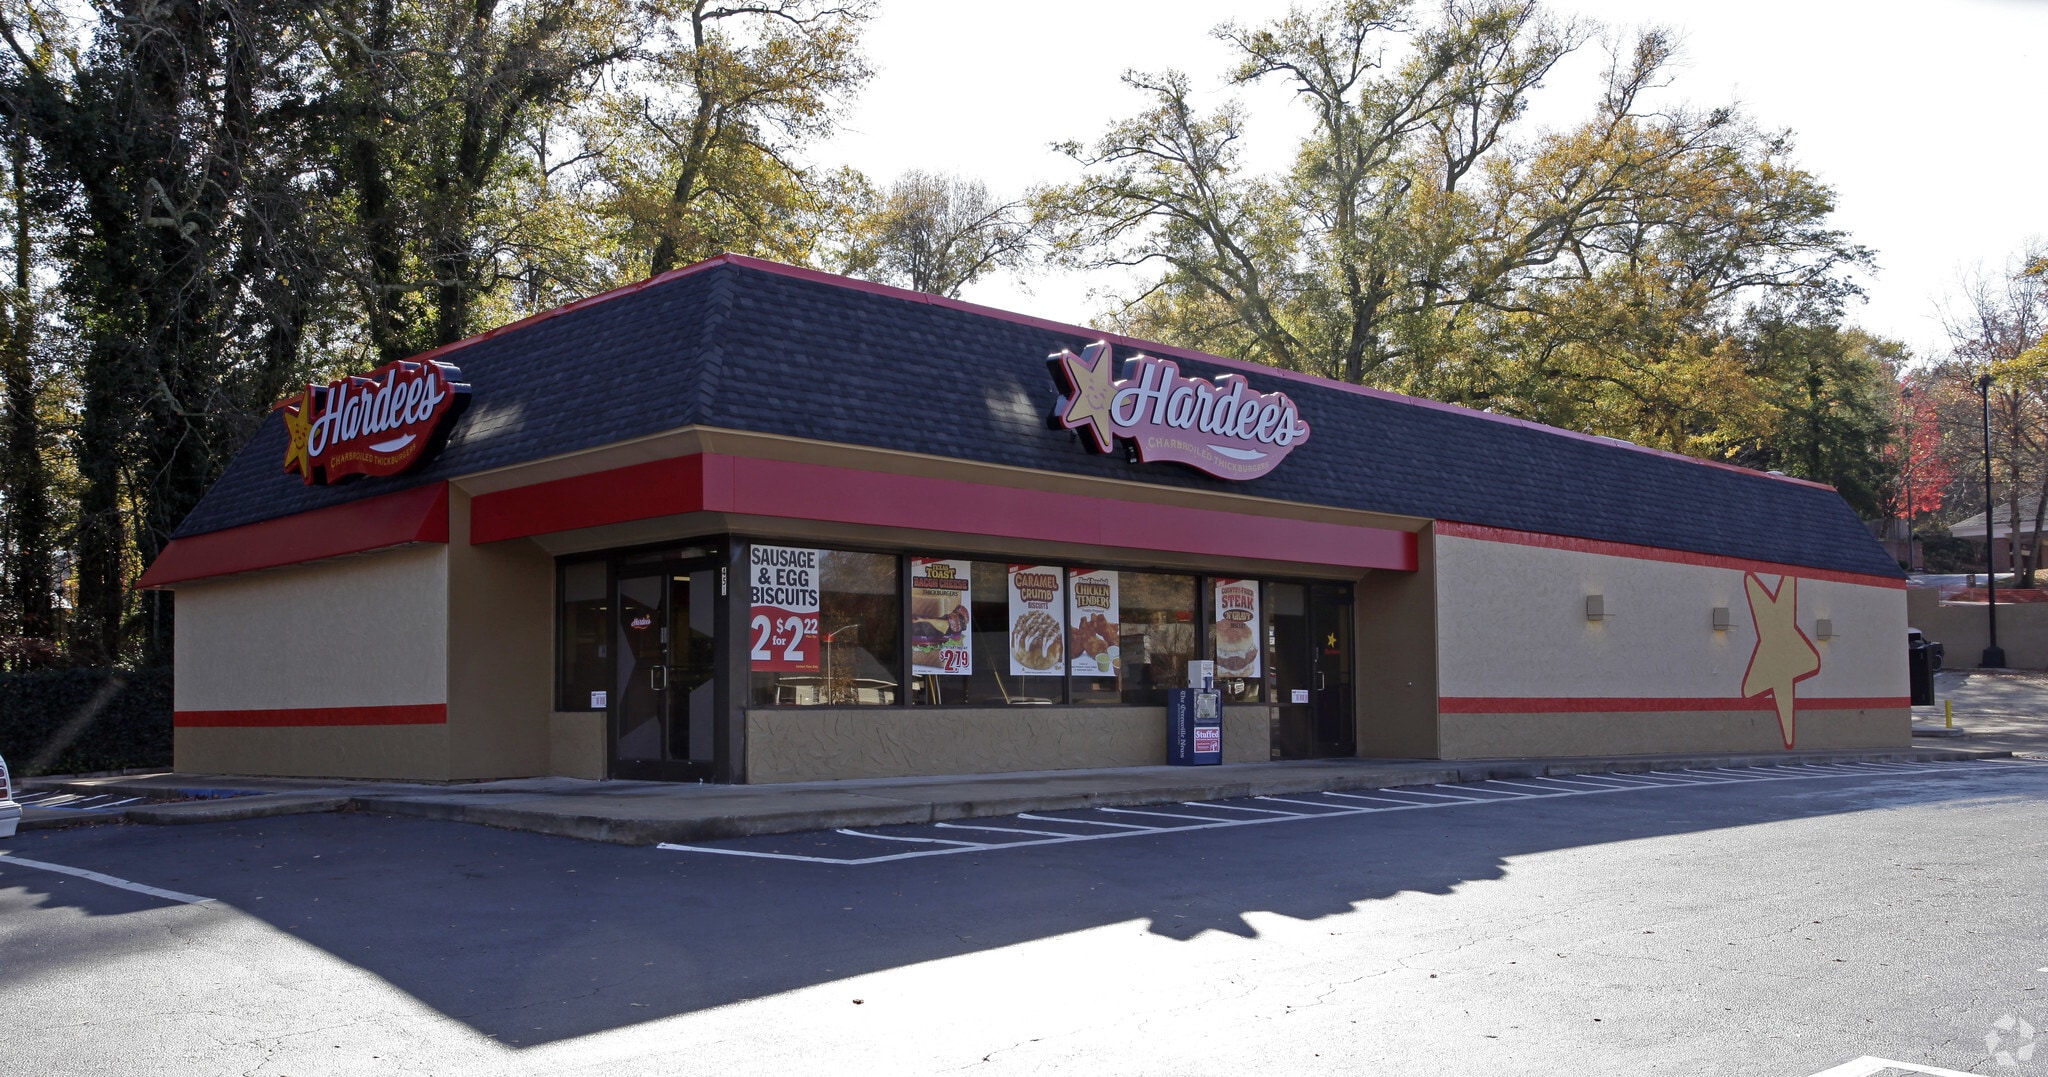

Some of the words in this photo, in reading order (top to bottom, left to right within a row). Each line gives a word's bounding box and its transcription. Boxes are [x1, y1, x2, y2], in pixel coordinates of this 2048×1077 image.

[308, 365, 445, 457] Hardee's
[1111, 363, 1305, 446] Hardee's
[1148, 437, 1212, 461] CHARBROILED
[331, 452, 373, 468] CHARBROILED
[751, 547, 815, 569] SAUSAGE
[758, 567, 771, 585] &
[776, 568, 809, 587] EGG
[926, 568, 956, 579] TOAST
[1015, 573, 1058, 590] CARAMEL
[914, 577, 939, 588] BACON
[939, 579, 968, 590] CHEESE
[1075, 583, 1110, 596] CHICKEN
[751, 586, 818, 606] BISCUITS
[1077, 595, 1110, 608] TENDERS
[1221, 594, 1254, 610] STEAK
[1027, 602, 1049, 610] BISCUITS
[751, 614, 771, 661] 2
[772, 635, 786, 646] for
[1195, 730, 1219, 739] Stuffed
